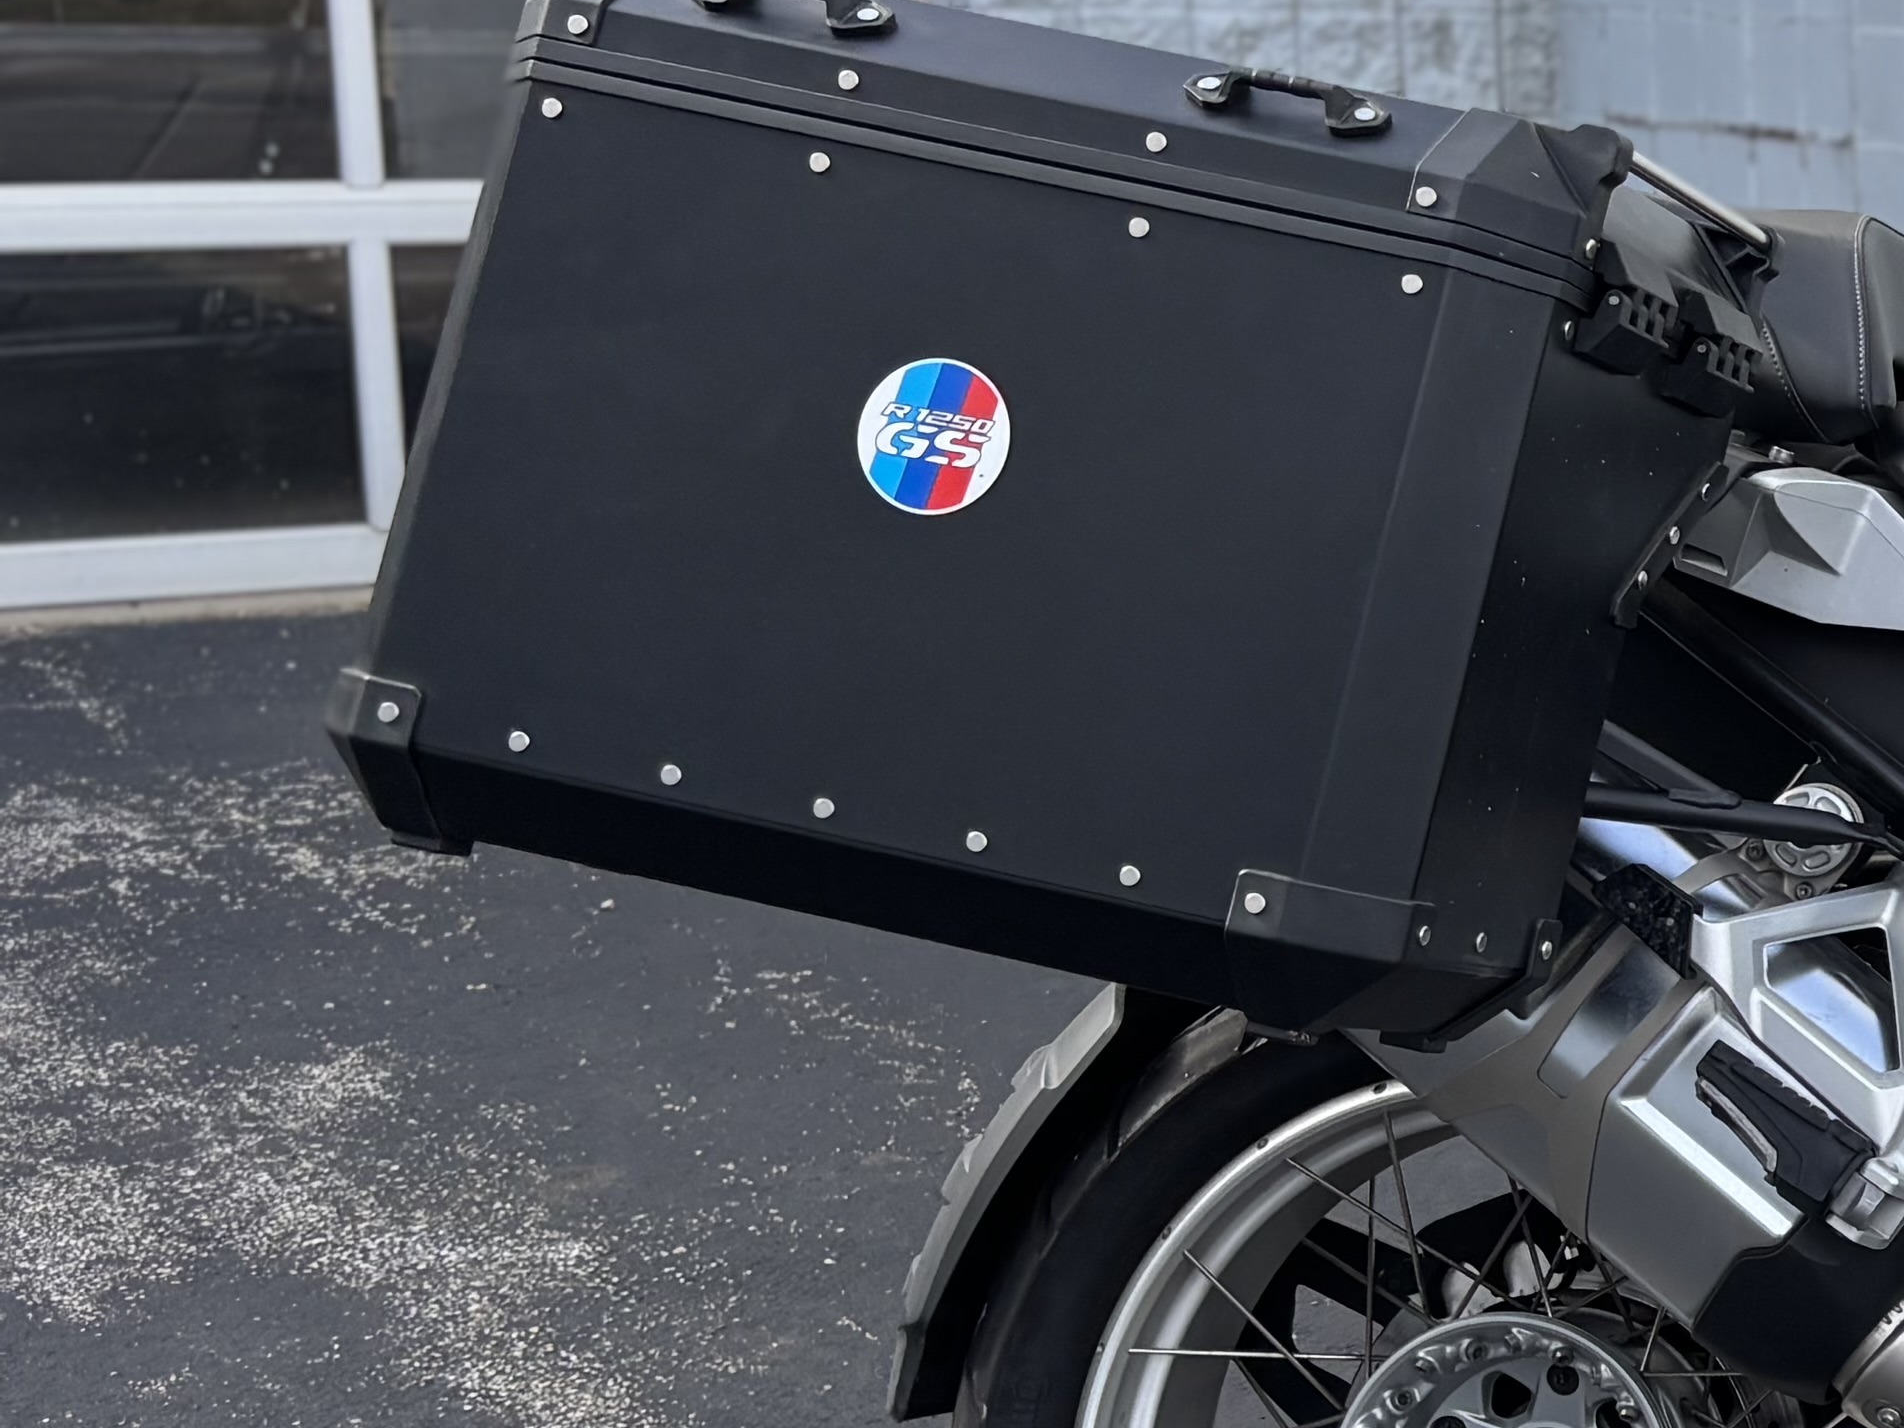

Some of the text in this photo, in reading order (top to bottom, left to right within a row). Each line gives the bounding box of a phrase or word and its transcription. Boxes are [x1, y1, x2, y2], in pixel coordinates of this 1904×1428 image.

[881, 401, 996, 435] R 1250
[874, 420, 992, 469] GS
